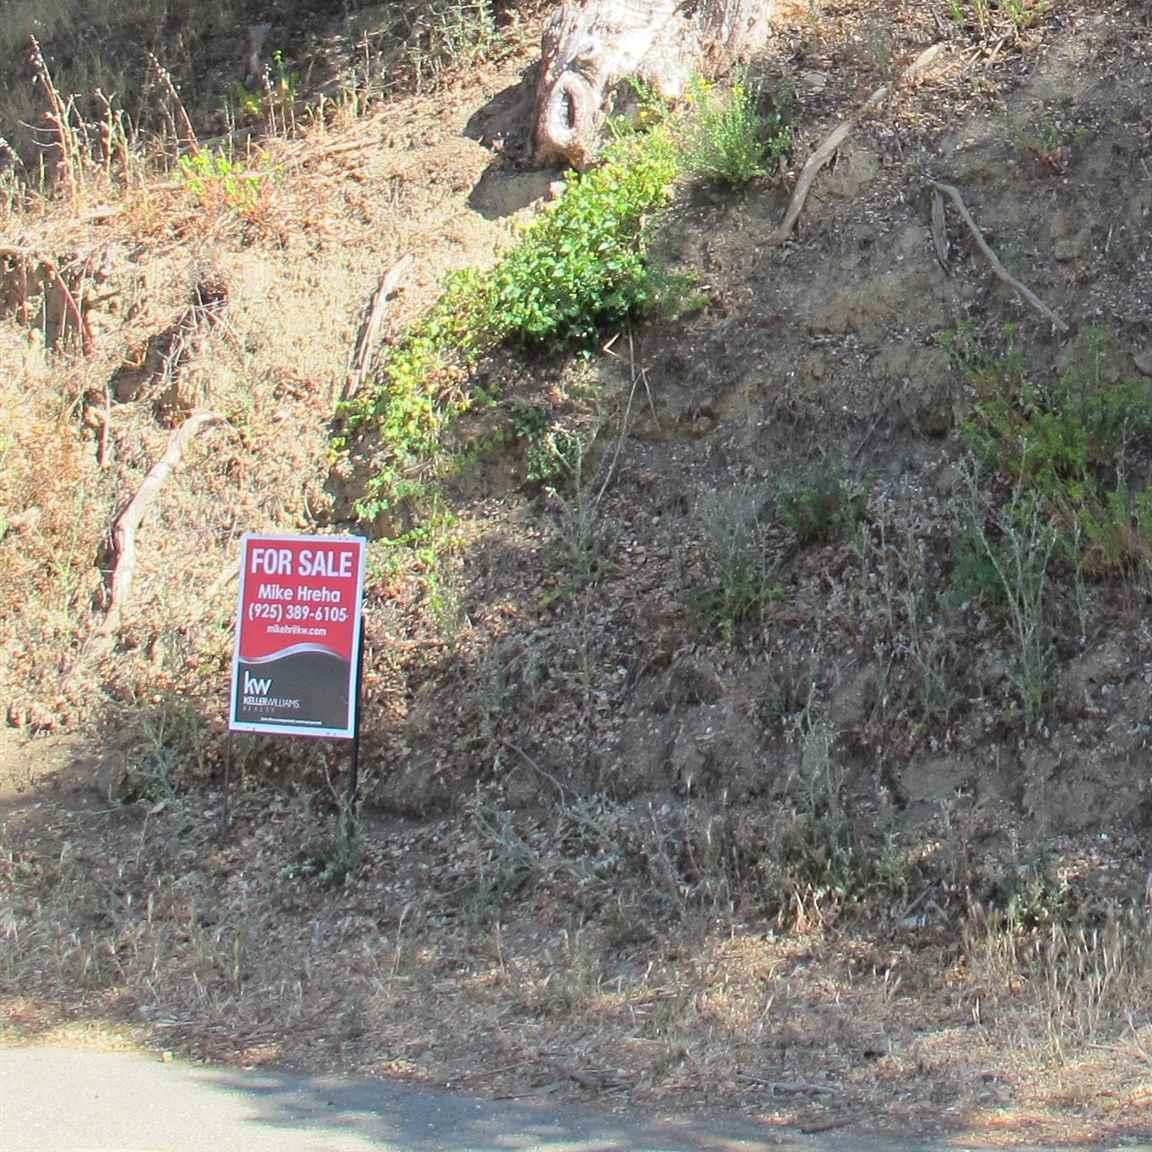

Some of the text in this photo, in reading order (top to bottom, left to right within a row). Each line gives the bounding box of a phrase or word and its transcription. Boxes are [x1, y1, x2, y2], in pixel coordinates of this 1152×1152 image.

[251, 548, 353, 578] FOR SALE
[258, 584, 341, 603] Mike Hreha
[248, 603, 347, 622] (925) 389-6105
[244, 671, 272, 695] kw
